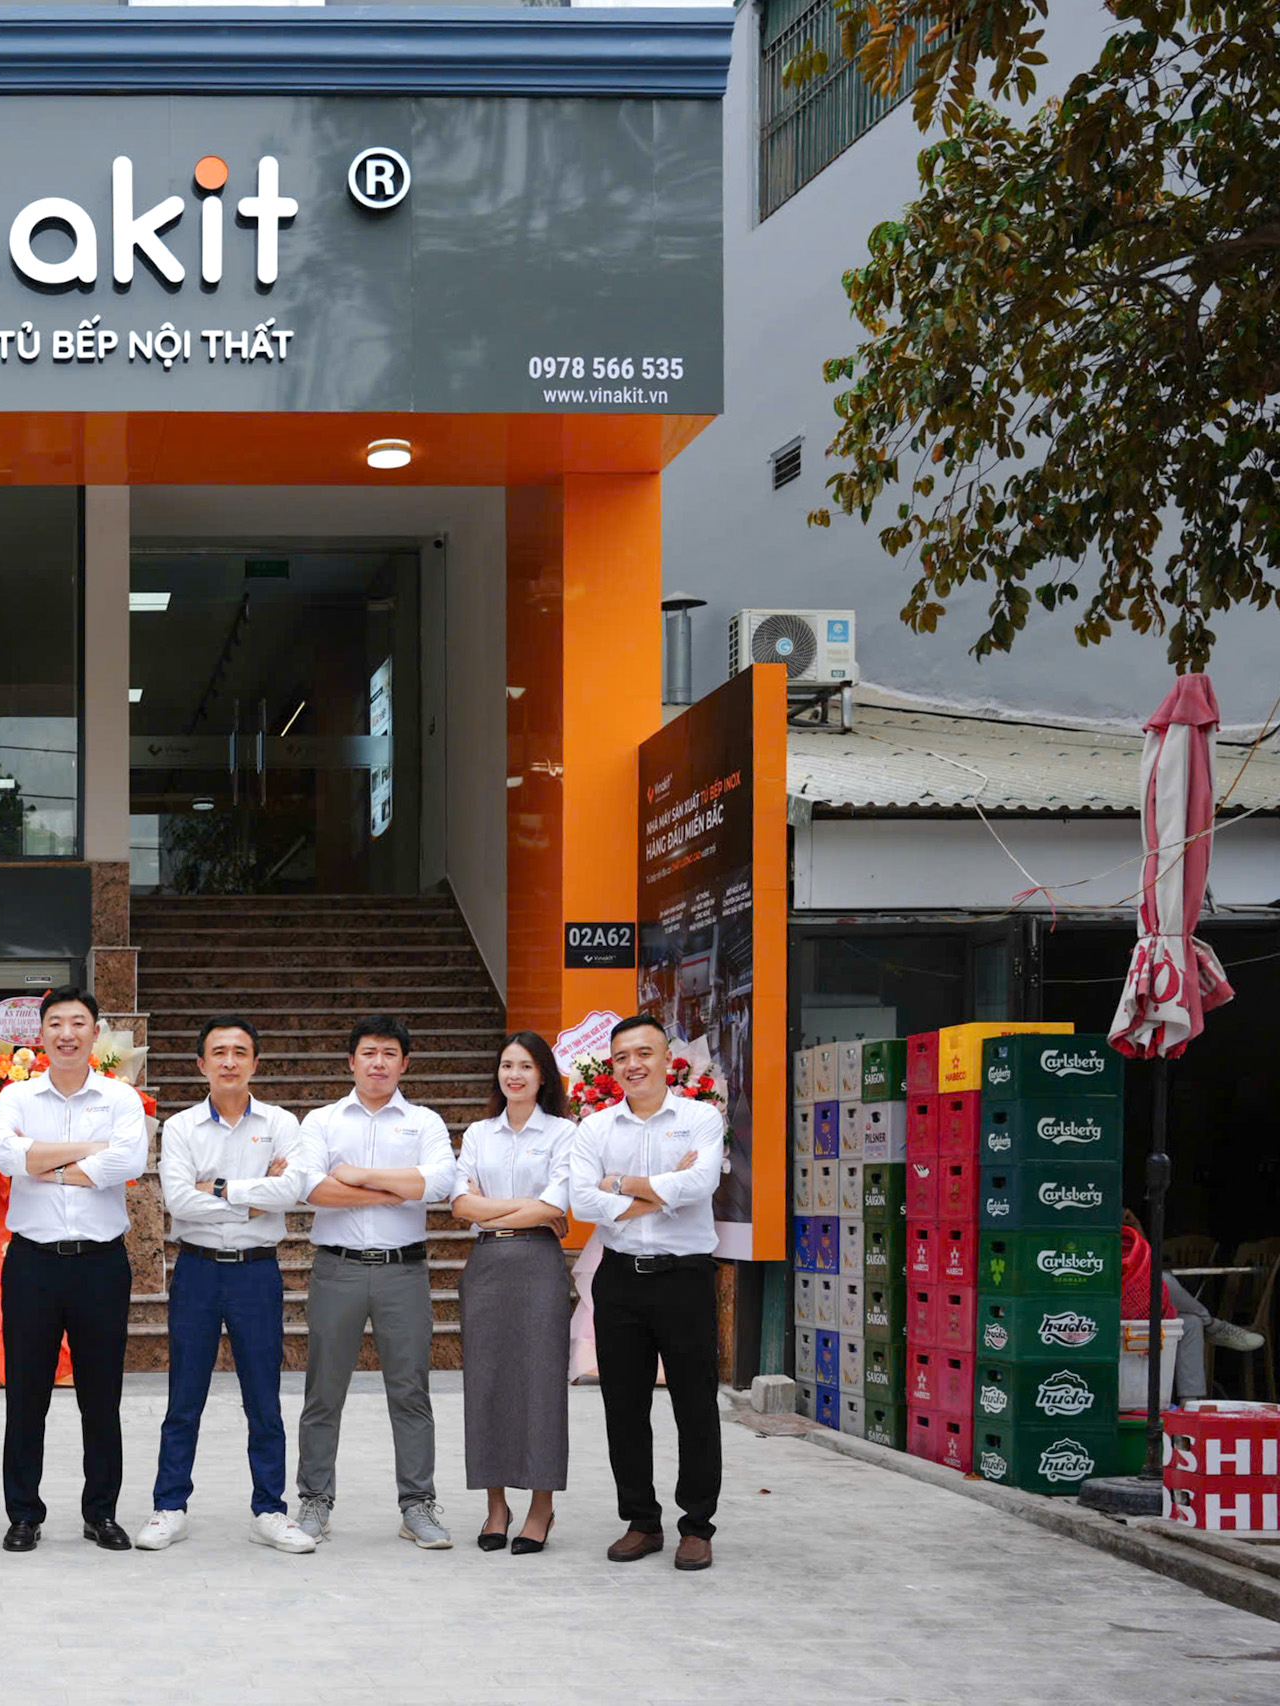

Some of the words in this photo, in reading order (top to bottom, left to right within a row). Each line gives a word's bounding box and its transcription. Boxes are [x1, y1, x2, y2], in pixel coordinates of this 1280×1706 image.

[52, 315, 118, 361] BẾP
[128, 322, 191, 368] NỘI
[202, 318, 295, 360] THẤT
[528, 356, 585, 379] 0978
[592, 357, 635, 379] 566
[642, 357, 684, 380] 535
[543, 386, 668, 404] www.vinakit.vn
[658, 808, 672, 829] MÁY
[671, 800, 684, 822] SẢN
[724, 770, 741, 792] INOX
[646, 834, 667, 862] HÀNG
[667, 822, 685, 850] ĐẦU
[685, 810, 705, 840] MIỀN
[706, 799, 724, 830] BẮC
[569, 927, 631, 946] 02A62
[1040, 1049, 1106, 1078] Carlsberg
[864, 1072, 885, 1085] SAIGON
[945, 1071, 967, 1082] HABECO
[865, 1132, 886, 1144] PILSNER
[1037, 1117, 1102, 1145] Carlsberg
[865, 1193, 886, 1208] SAIGON
[1038, 1182, 1103, 1210] Carlsberg
[866, 1253, 887, 1266] SAIGON
[1037, 1250, 1105, 1276] Carlsberg
[866, 1313, 888, 1326] SAIGON
[1040, 1314, 1098, 1334] huda
[866, 1372, 889, 1385] SAIGON
[982, 1388, 1007, 1406] huda
[1038, 1387, 1094, 1406] huda
[868, 1430, 891, 1445] SAIGON
[981, 1454, 1006, 1473] huda
[1040, 1454, 1095, 1473] huda
